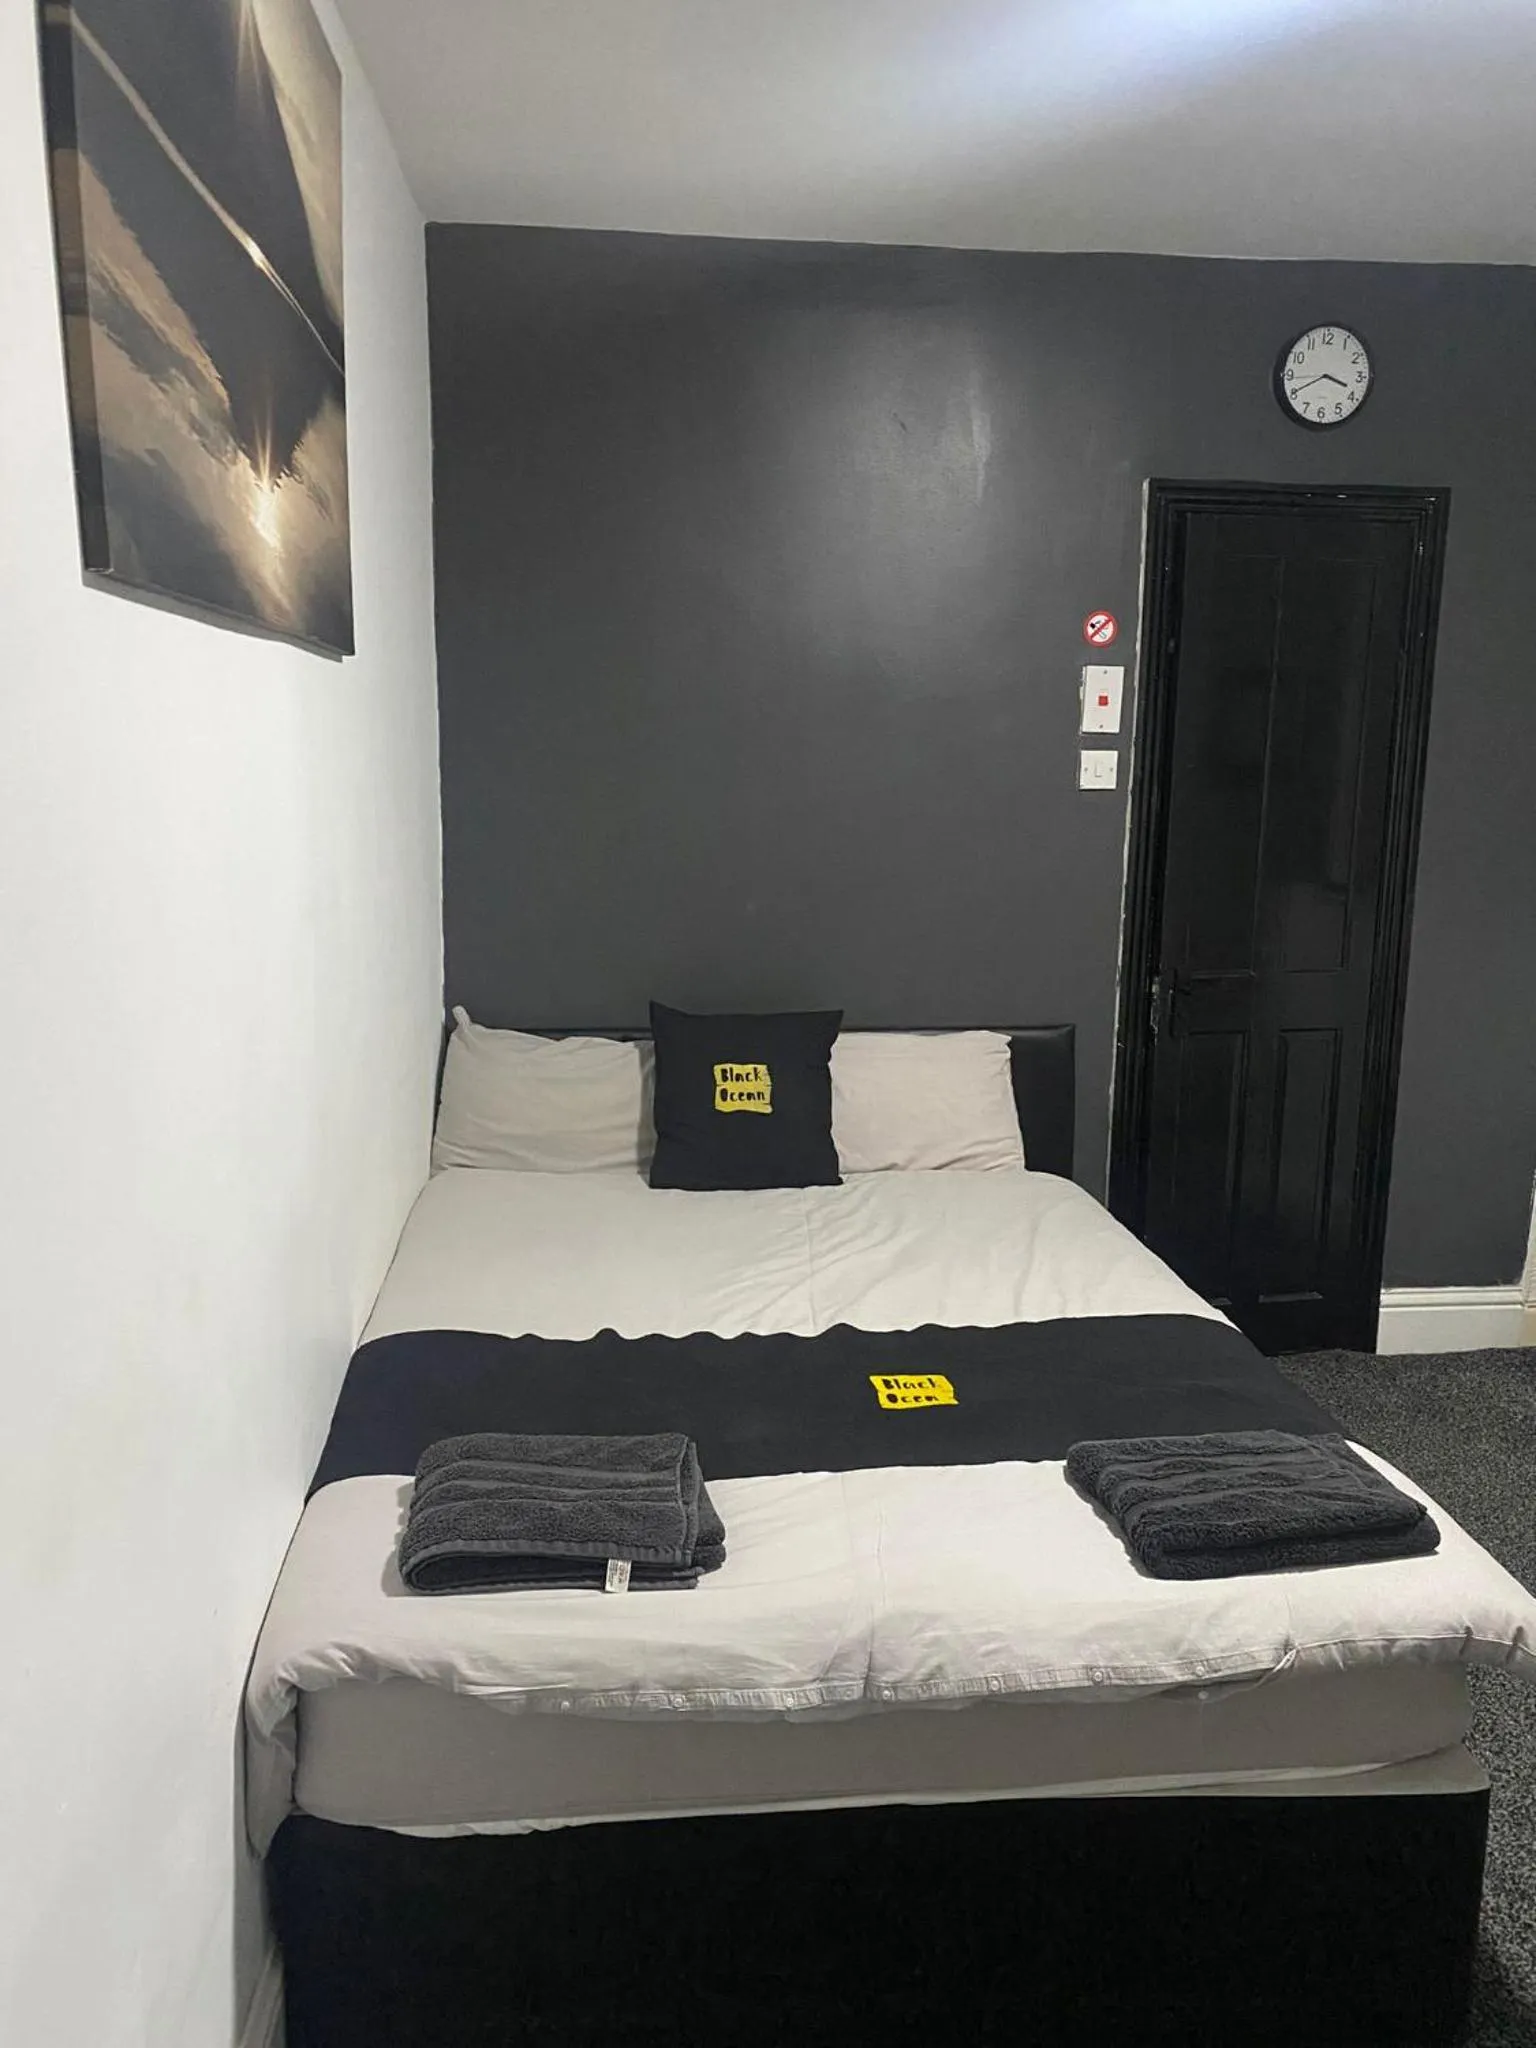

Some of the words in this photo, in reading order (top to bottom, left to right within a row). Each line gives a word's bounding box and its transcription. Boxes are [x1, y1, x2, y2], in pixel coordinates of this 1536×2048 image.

[1308, 337, 1315, 351] 11
[1322, 332, 1335, 345] 12
[1293, 351, 1305, 364] 10
[1351, 351, 1360, 365] 2
[1285, 368, 1294, 381] 9
[1355, 370, 1363, 383] 3
[1290, 387, 1298, 400] 8
[1347, 390, 1354, 403] 4
[1302, 402, 1311, 414] 7
[1316, 406, 1325, 419] 6
[1334, 402, 1343, 415] 5
[720, 1066, 763, 1083] Black
[719, 1087, 766, 1103] Ocean
